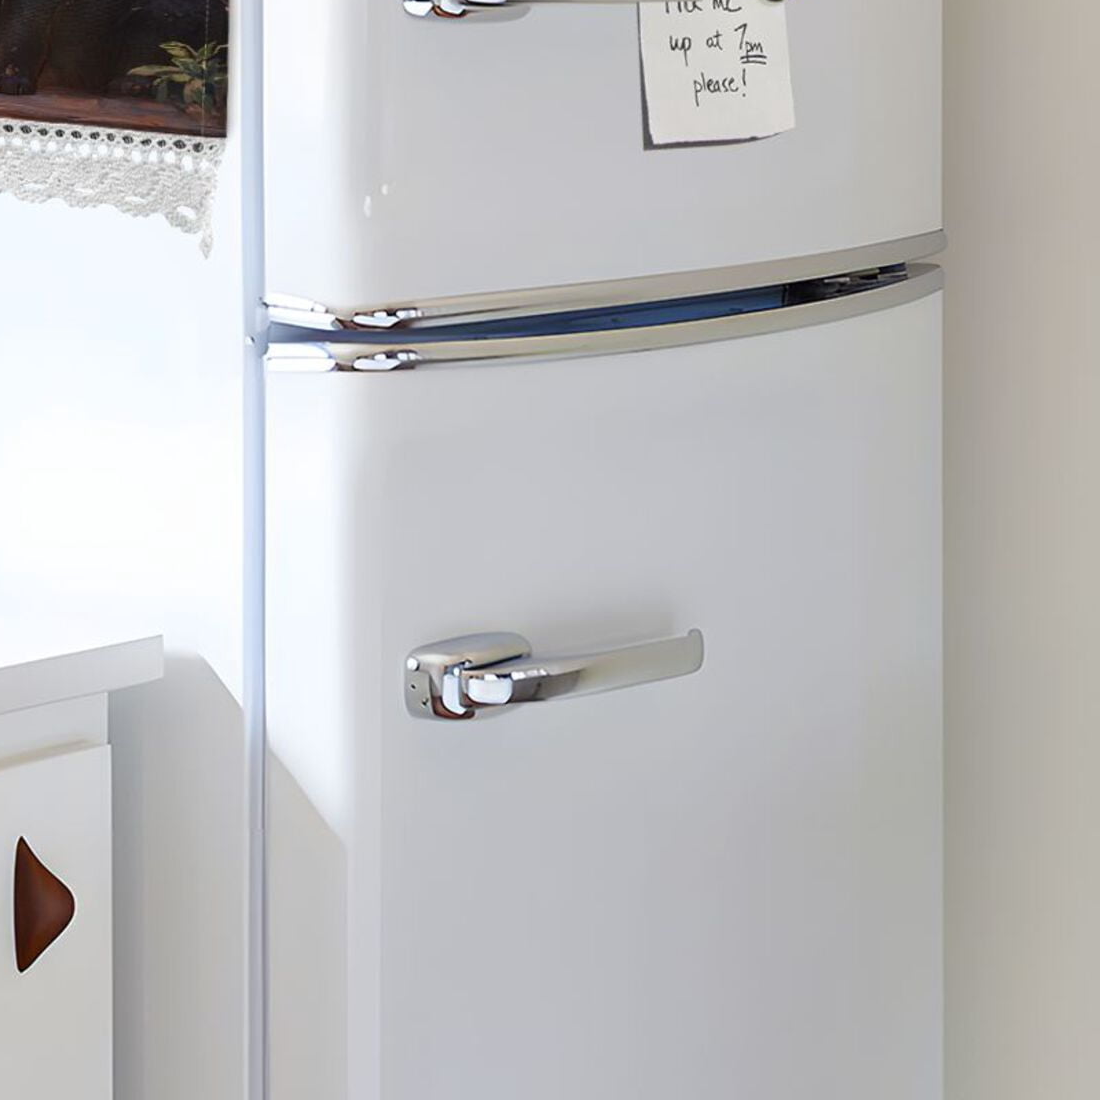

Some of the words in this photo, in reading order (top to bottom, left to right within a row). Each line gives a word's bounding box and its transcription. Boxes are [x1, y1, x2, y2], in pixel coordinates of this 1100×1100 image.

[669, 35, 692, 67] up
[706, 29, 723, 51] at
[693, 68, 747, 107] please!
